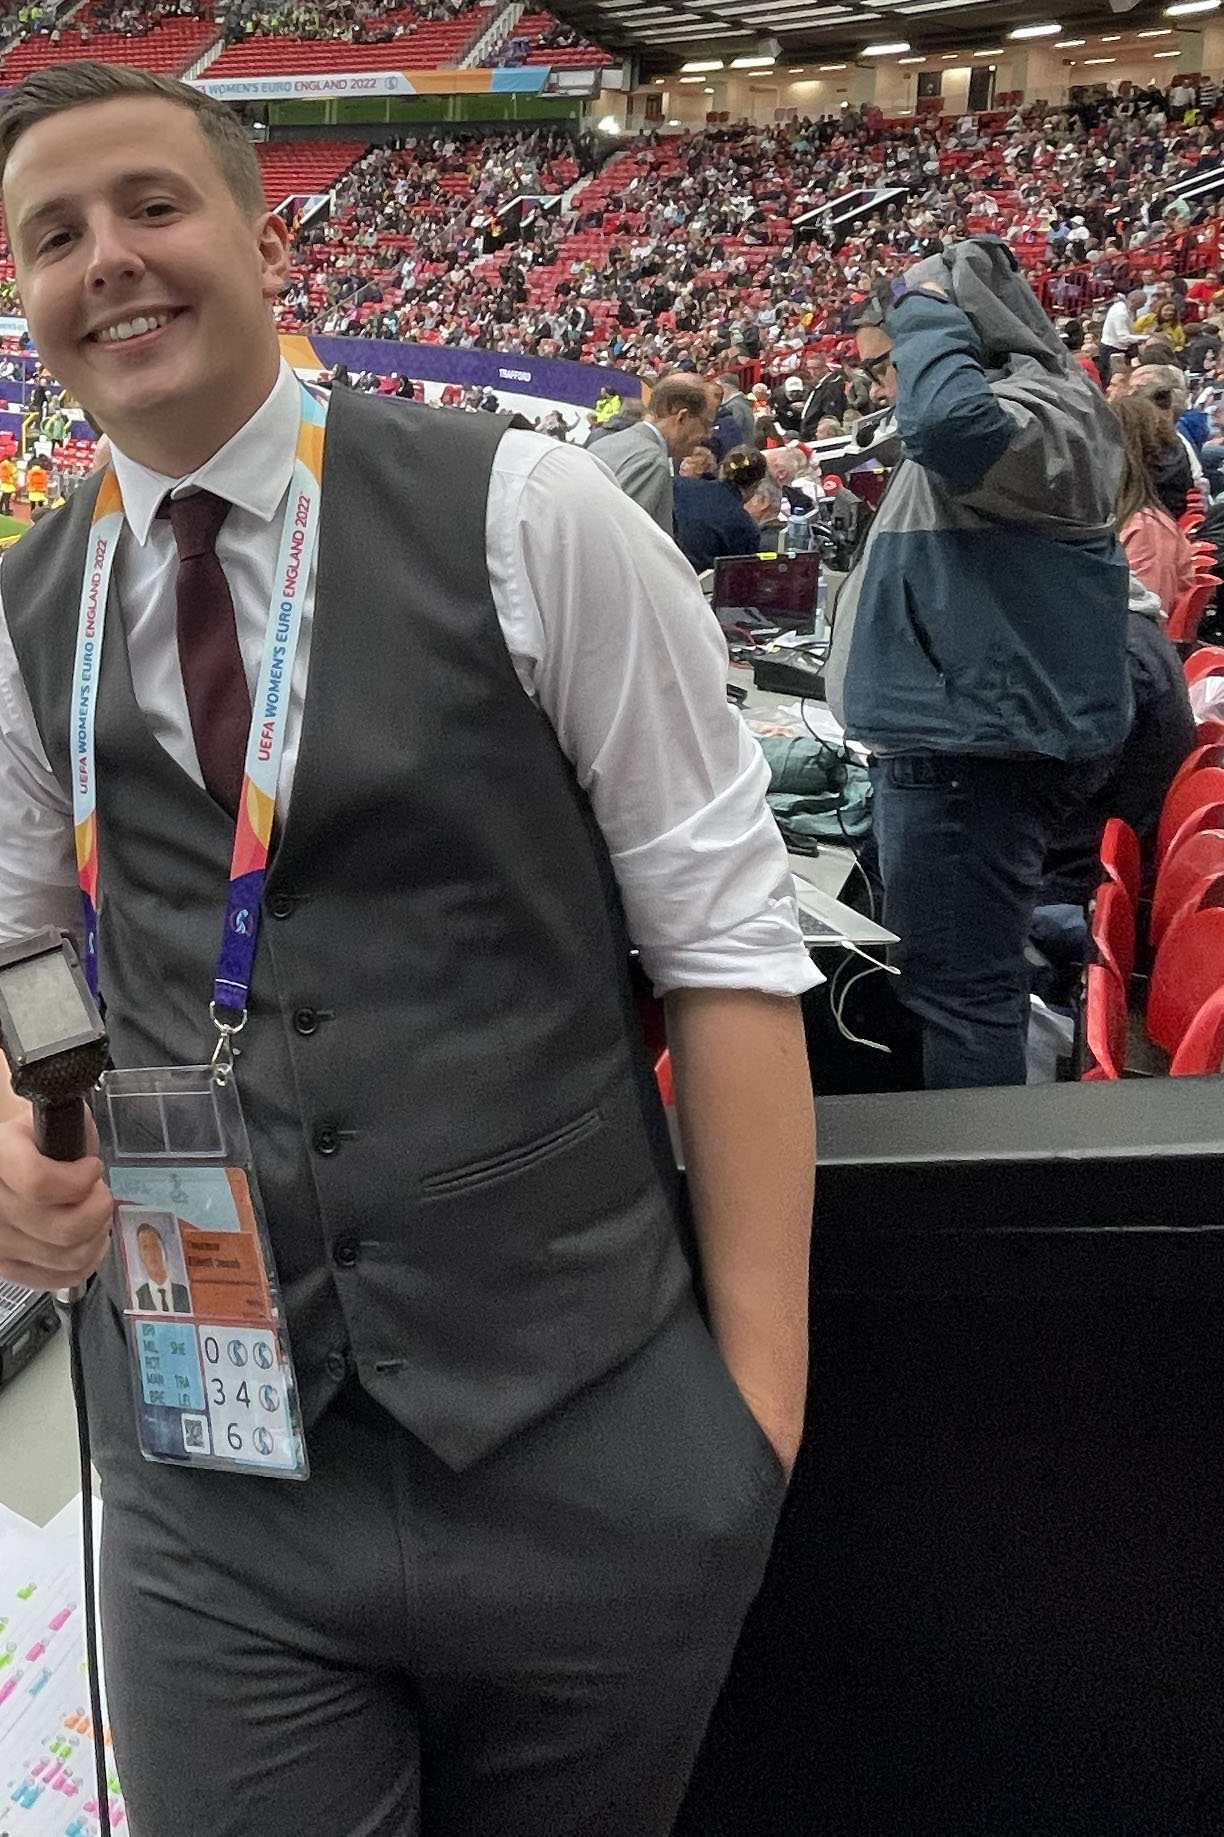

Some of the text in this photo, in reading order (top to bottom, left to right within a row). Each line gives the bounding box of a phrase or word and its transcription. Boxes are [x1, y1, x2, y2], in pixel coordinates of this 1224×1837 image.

[209, 83, 259, 94] WOMEN'S
[262, 82, 291, 93] EURO
[294, 79, 347, 91] ENGLAND
[350, 78, 377, 89] 2022
[258, 495, 311, 762] UEFA WOMEN'S EURO ENGLAND 2022
[78, 539, 107, 794] UEFA WOMEN'S EURO ENGLAND 2022
[211, 1377, 251, 1409] 3 4
[227, 1422, 242, 1450] 6
